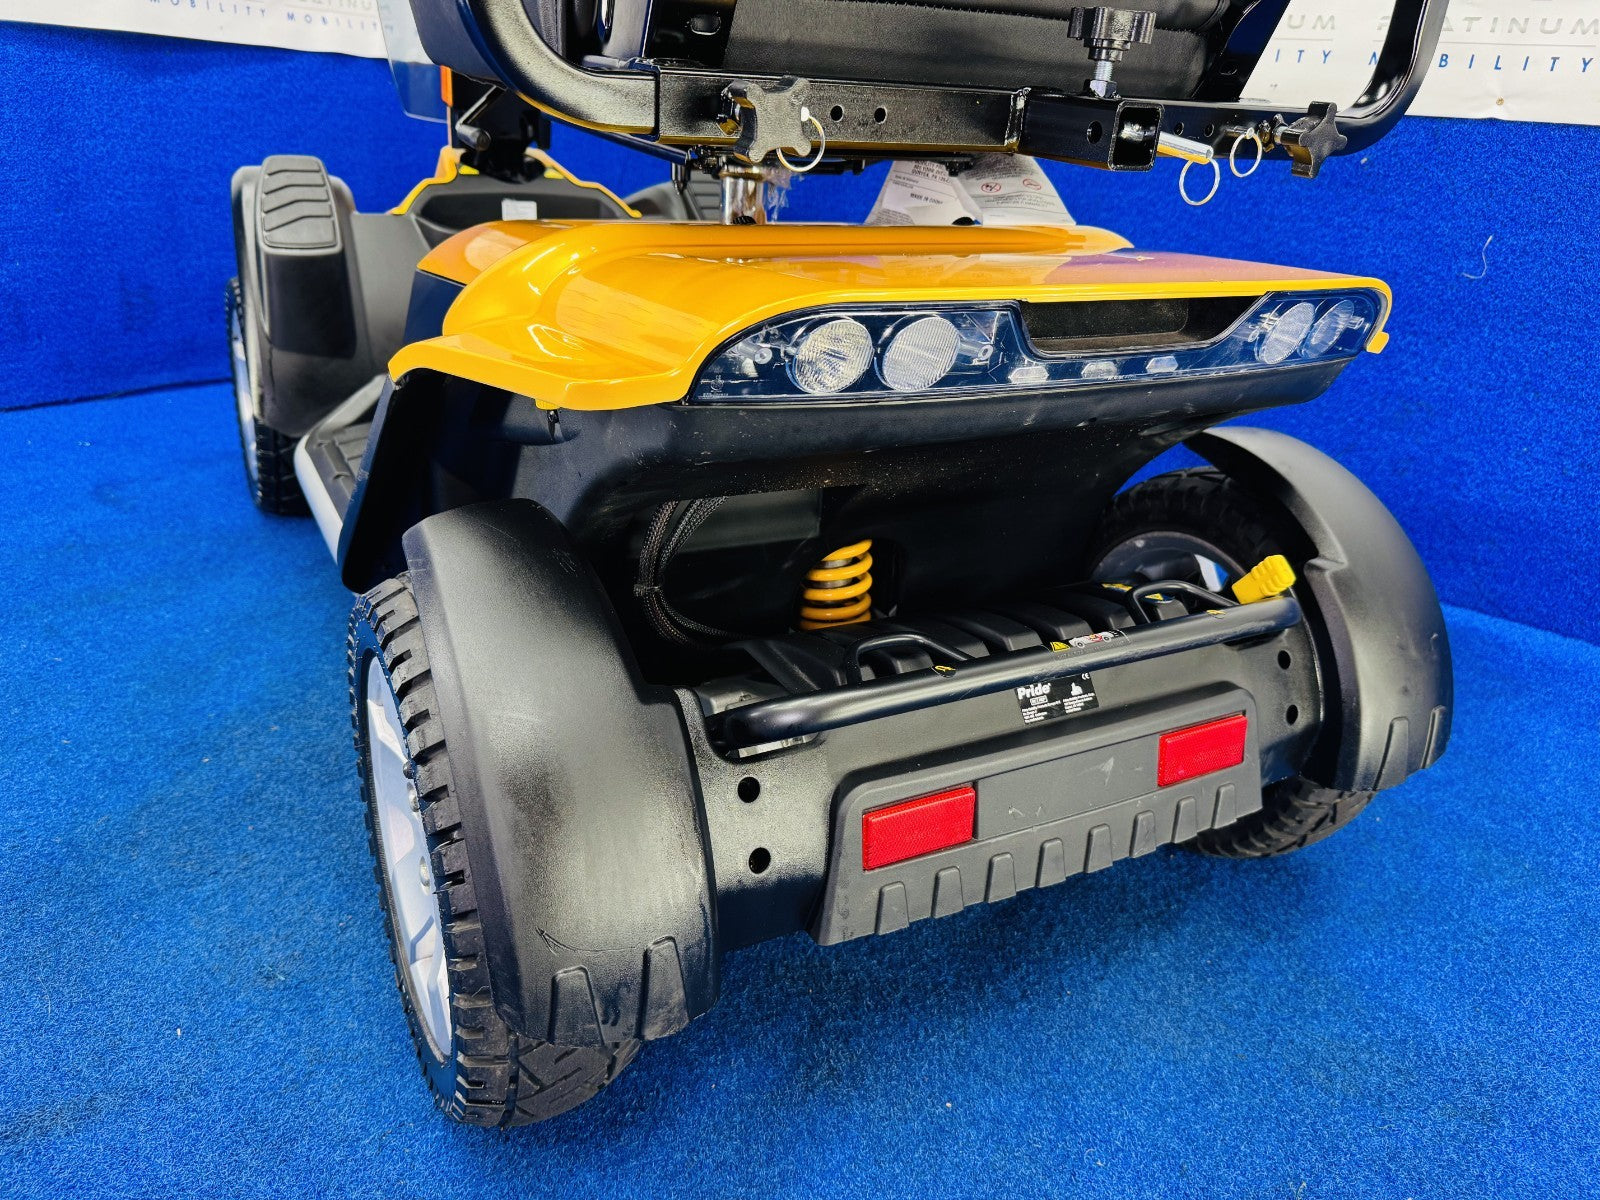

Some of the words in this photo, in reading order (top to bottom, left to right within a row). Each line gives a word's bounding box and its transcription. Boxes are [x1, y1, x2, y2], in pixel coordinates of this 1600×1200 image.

[1376, 16, 1600, 35] PATINUM
[1368, 51, 1594, 73] MBILITY
[1017, 682, 1051, 700] Pride
